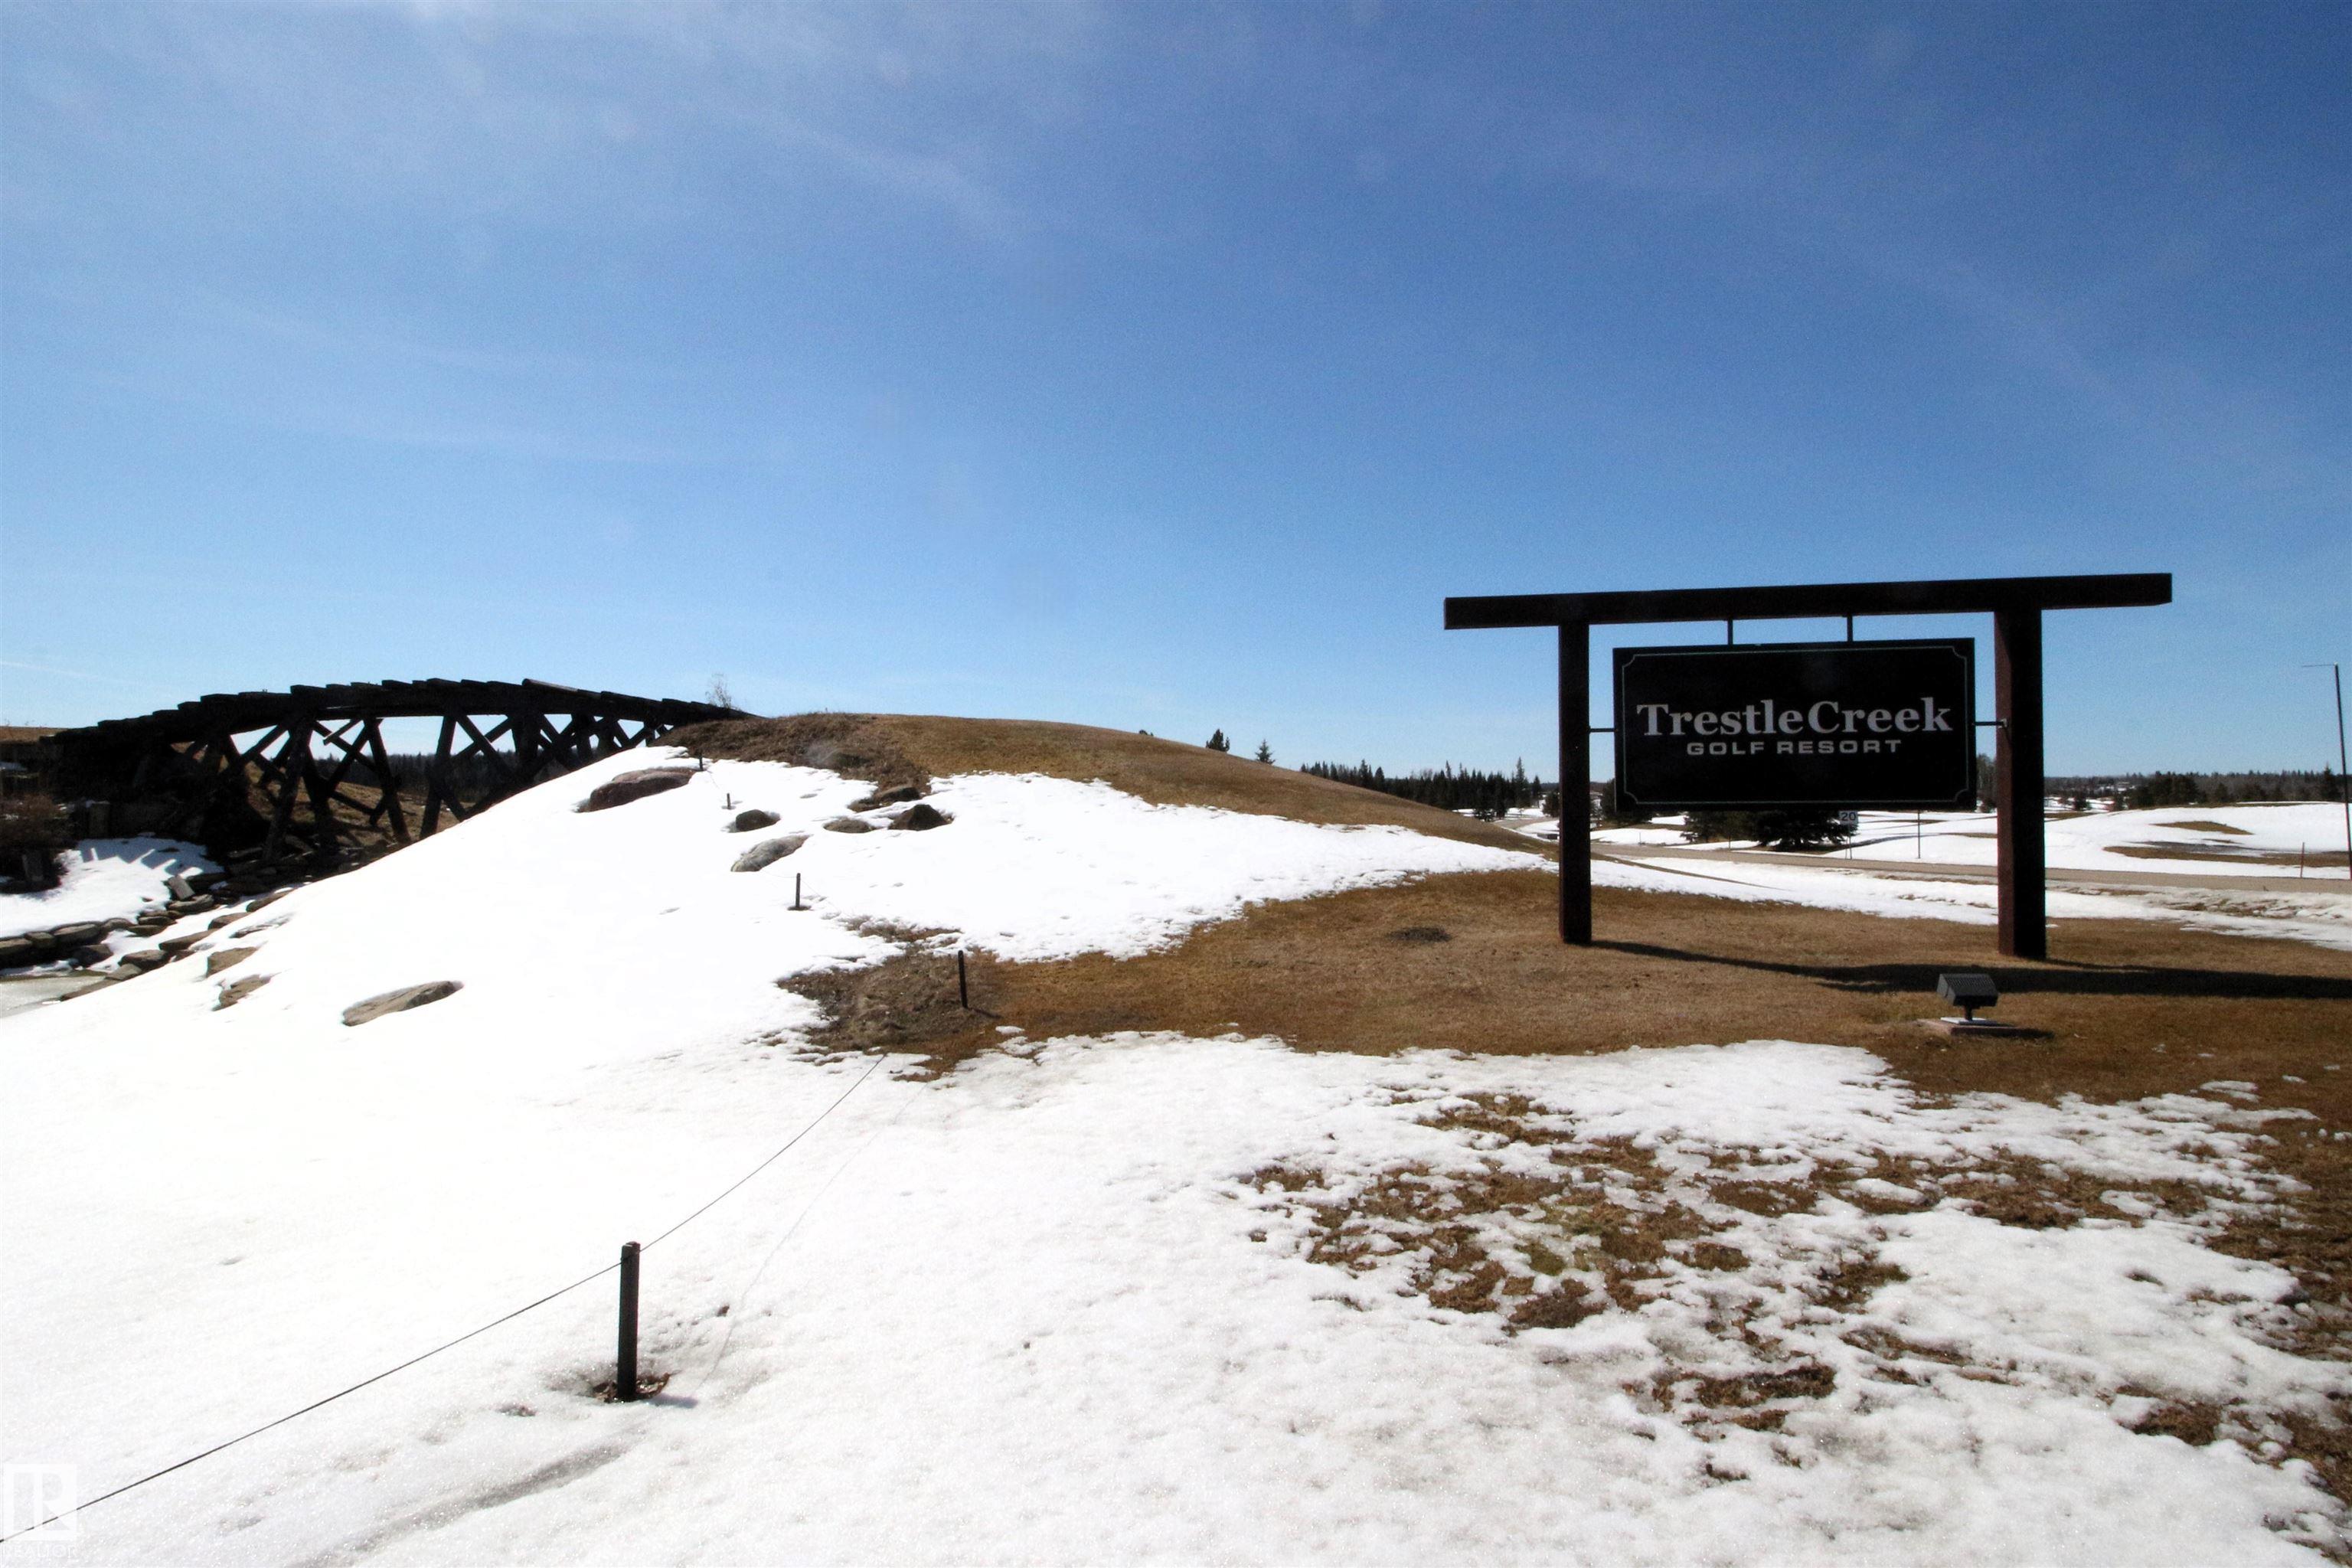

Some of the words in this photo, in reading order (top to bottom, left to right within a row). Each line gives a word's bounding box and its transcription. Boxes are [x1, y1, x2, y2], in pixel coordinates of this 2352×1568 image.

[1687, 741, 1764, 756] GOLF
[1777, 740, 1902, 754] RESORT
[1841, 812, 1857, 822] 20
